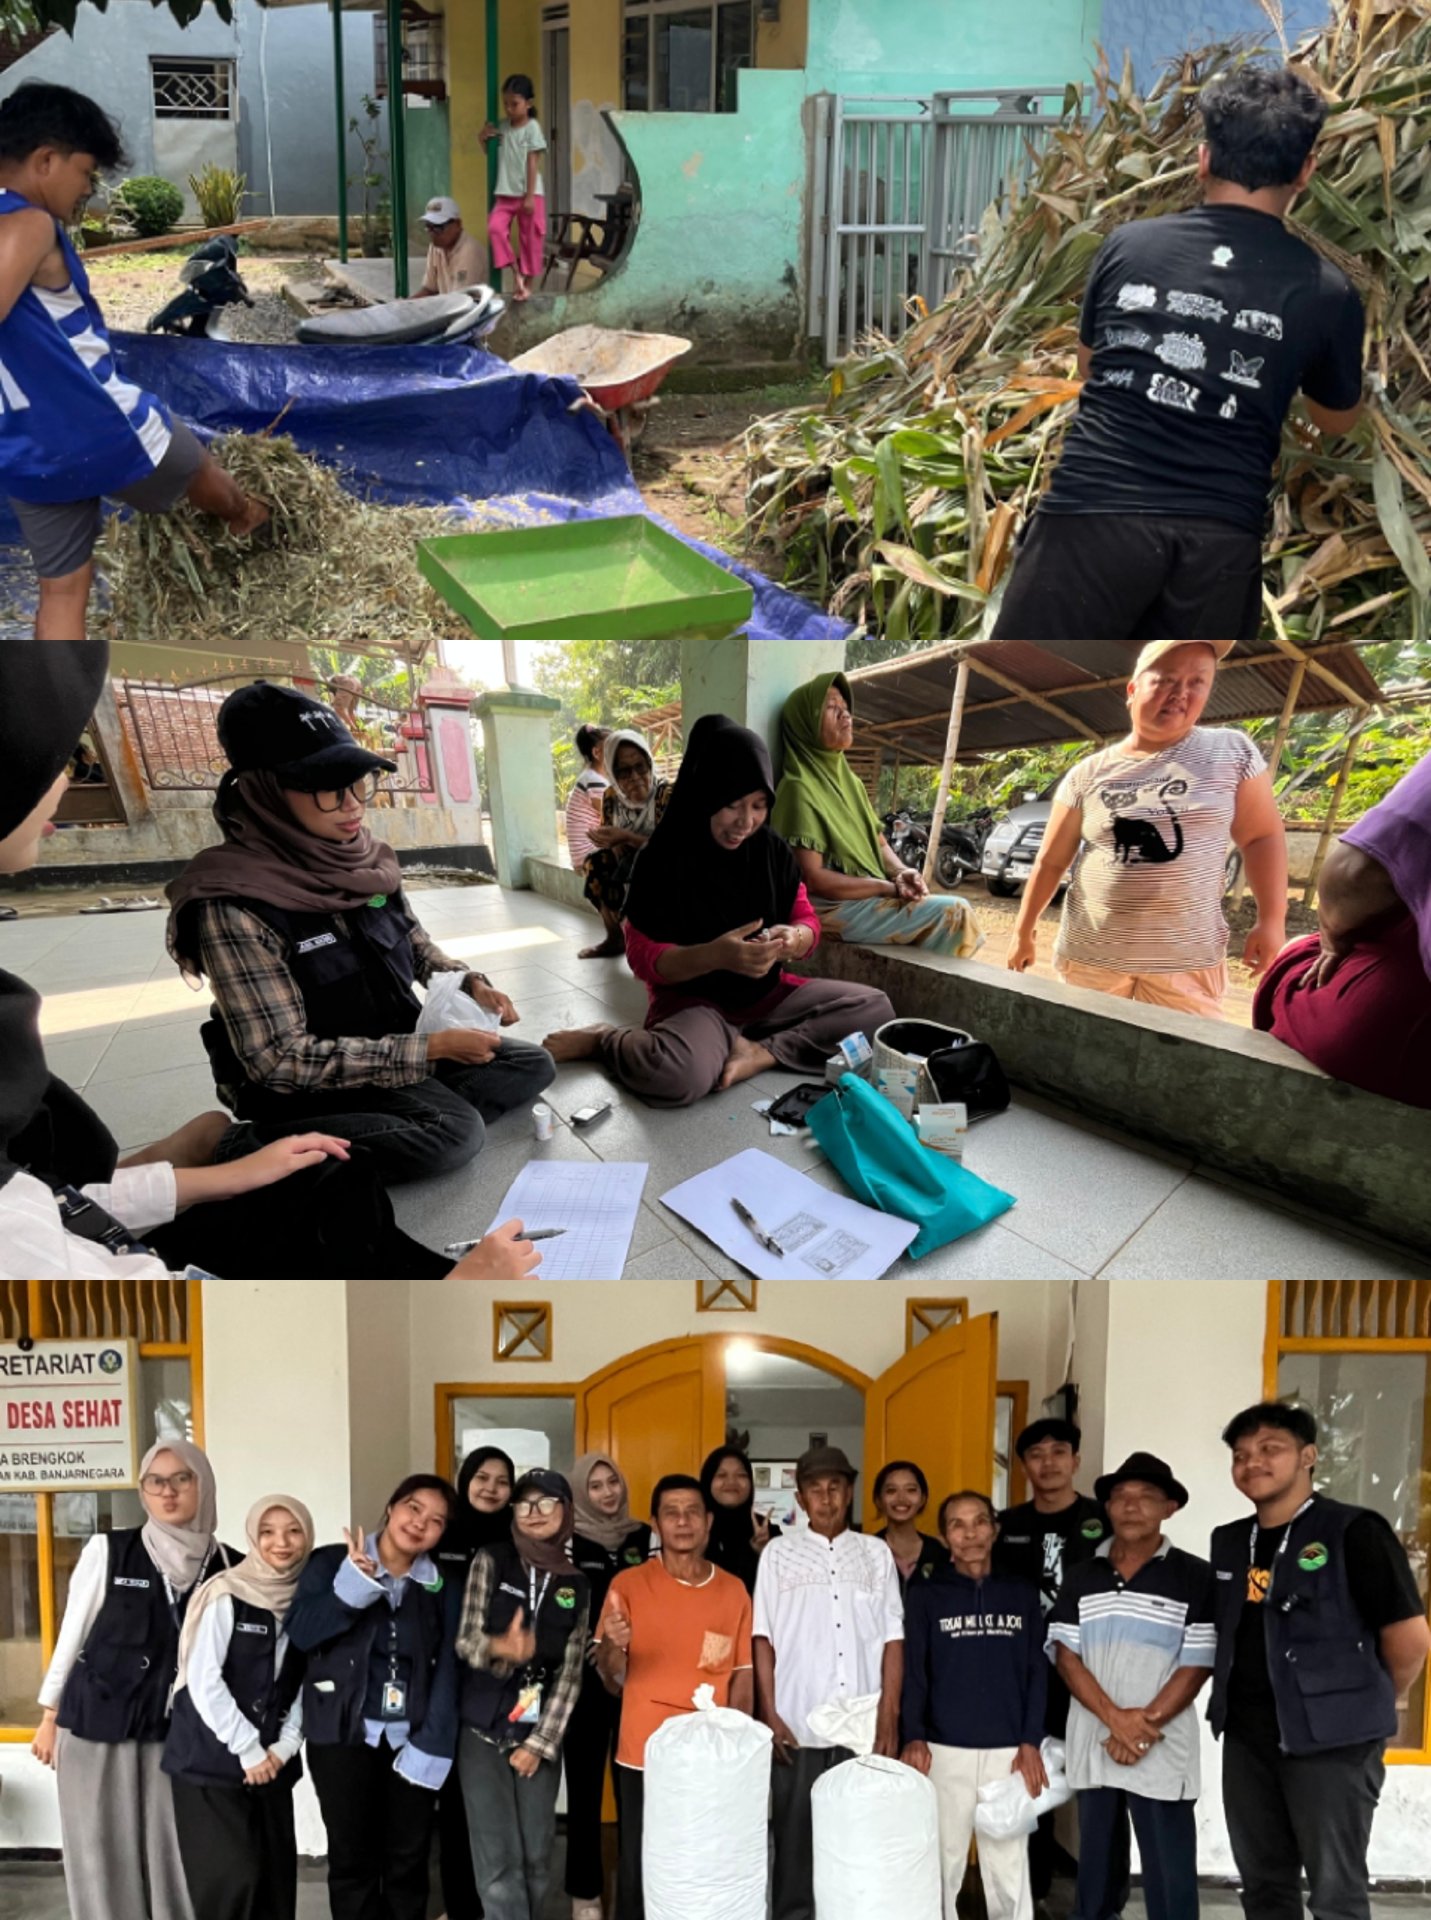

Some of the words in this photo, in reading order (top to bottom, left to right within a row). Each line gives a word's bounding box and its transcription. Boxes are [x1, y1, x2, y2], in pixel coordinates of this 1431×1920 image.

[7, 1401, 56, 1429] DESA
[63, 1399, 122, 1428] SEHAT
[12, 1451, 85, 1465] BRENGKOK
[40, 1467, 125, 1480] BANJARNEGARA
